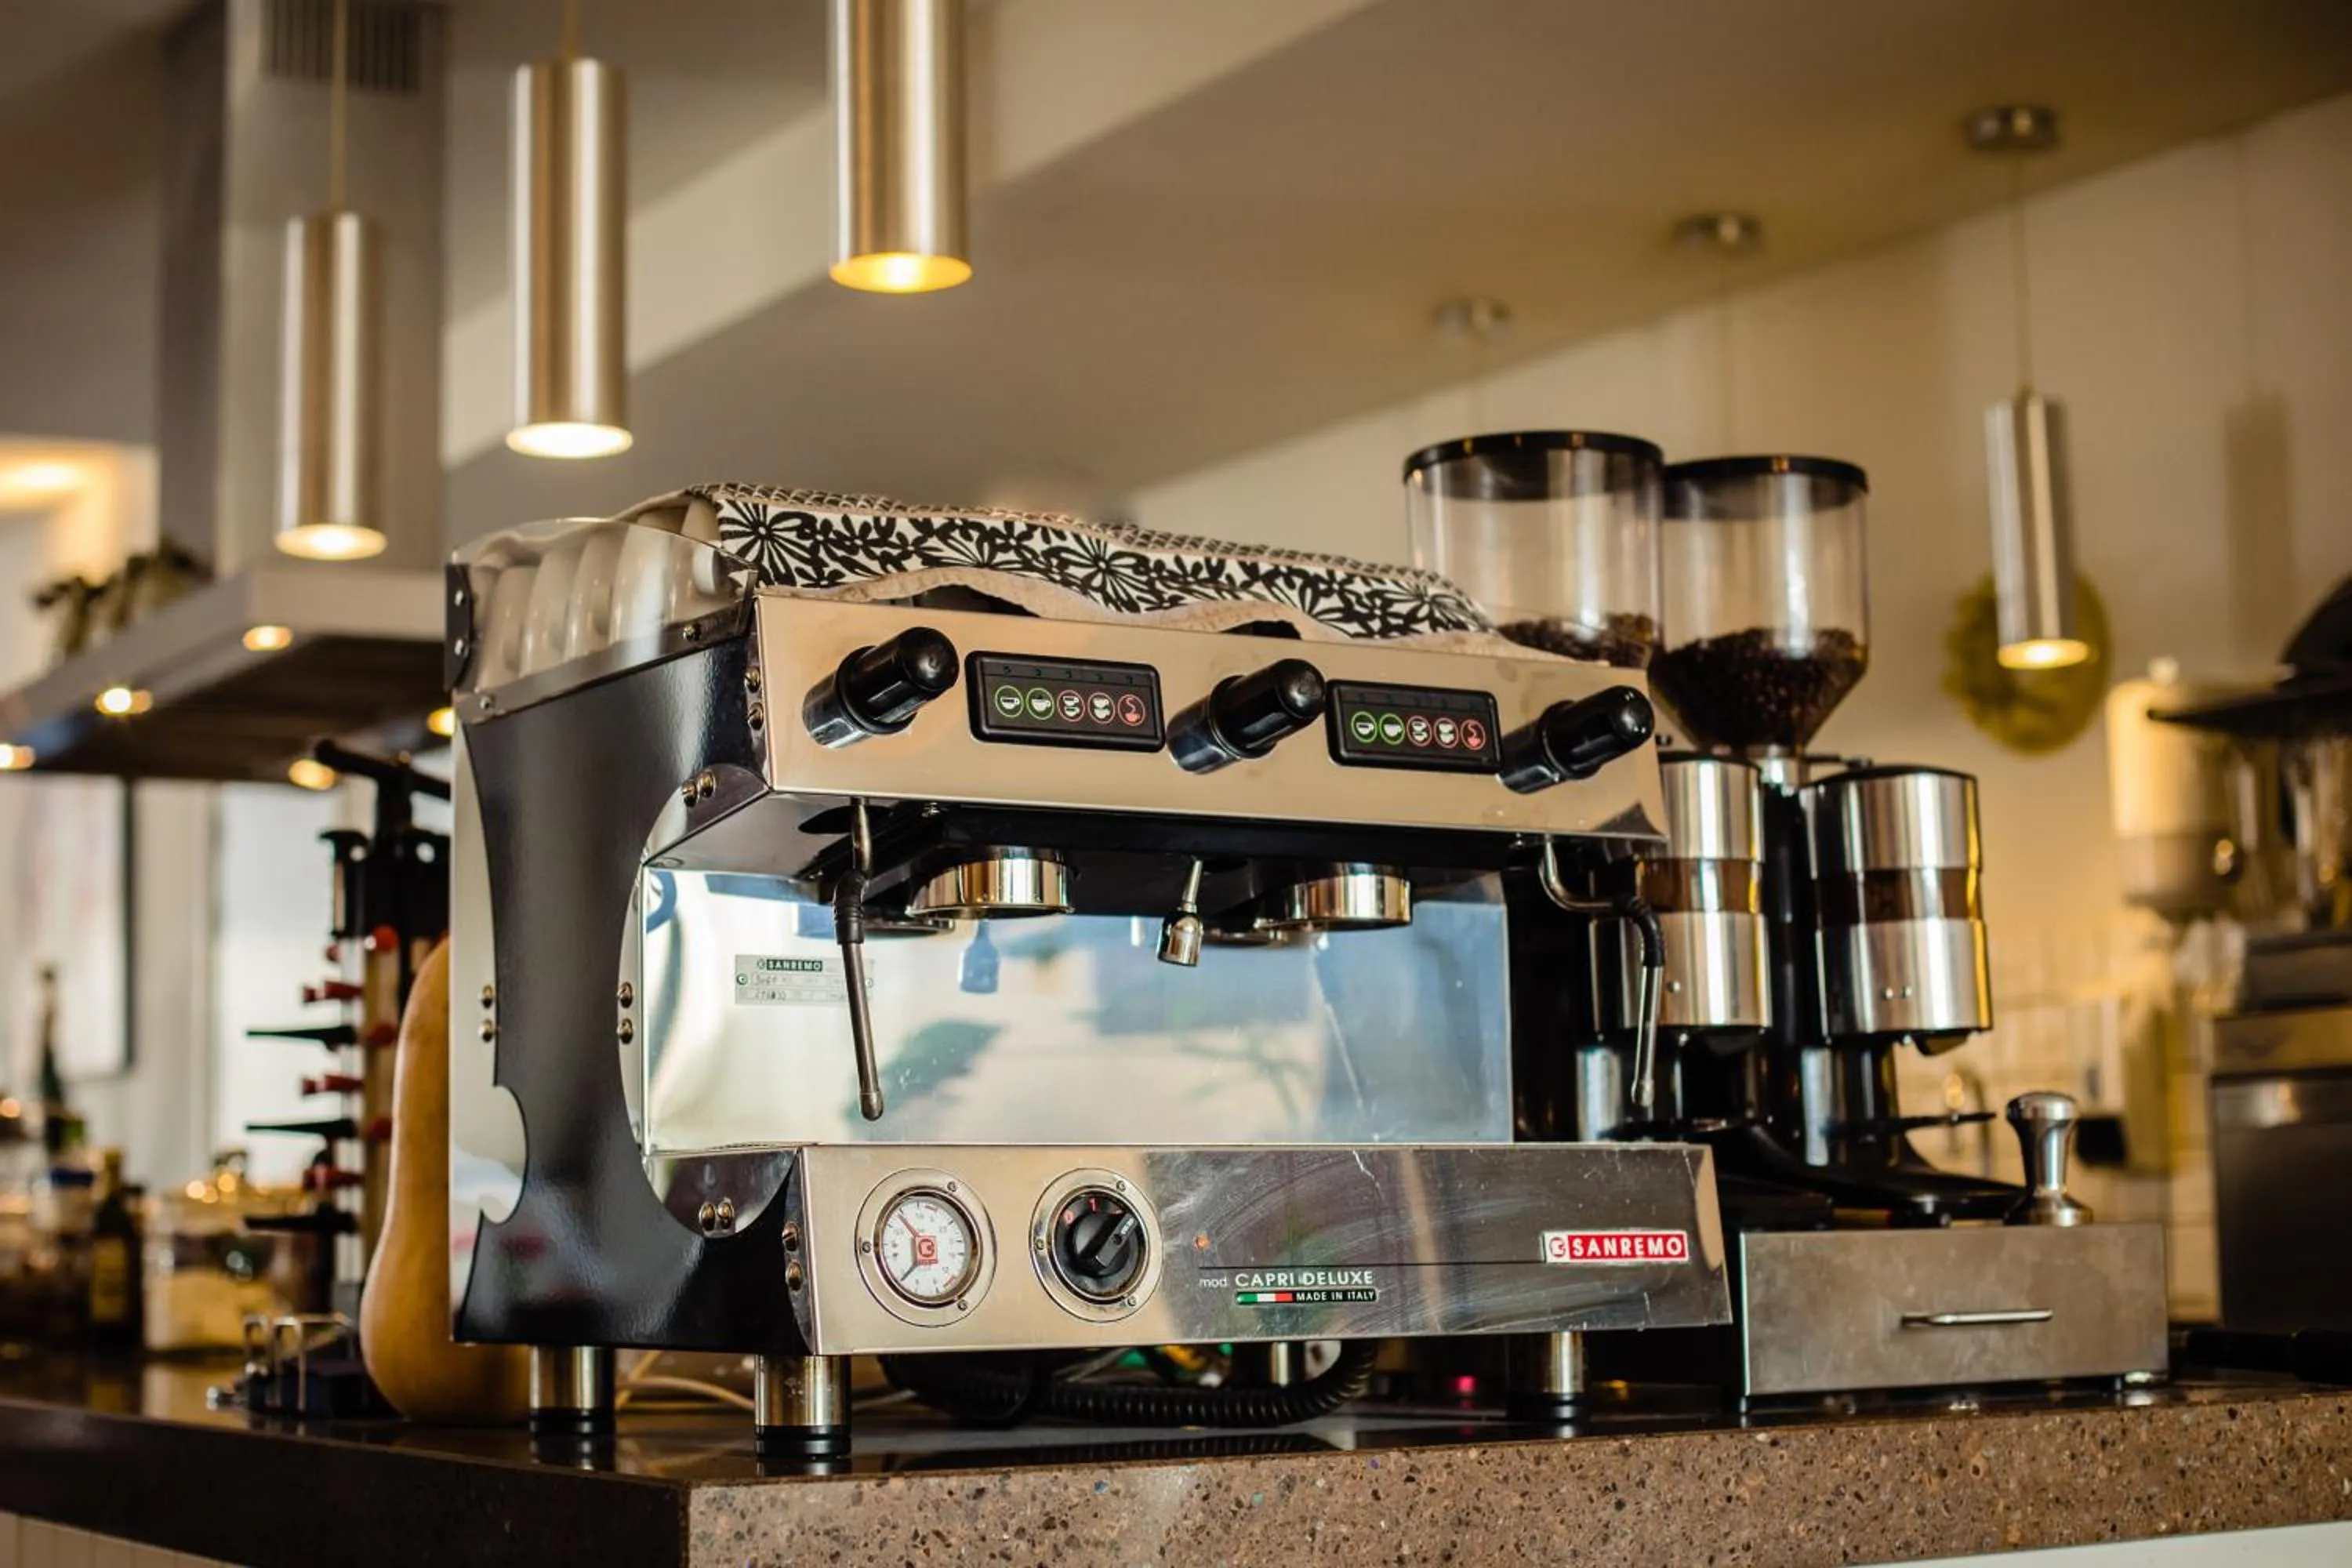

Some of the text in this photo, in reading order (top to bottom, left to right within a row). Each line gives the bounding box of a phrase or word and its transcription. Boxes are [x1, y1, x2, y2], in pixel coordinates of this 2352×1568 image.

[768, 960, 822, 971] SANREMO
[1572, 1236, 1683, 1258] SANREMO
[1235, 1272, 1295, 1287] CAPRI
[1301, 1270, 1374, 1286] DELUXE
[1296, 1290, 1374, 1301] MADE IN ITALY
